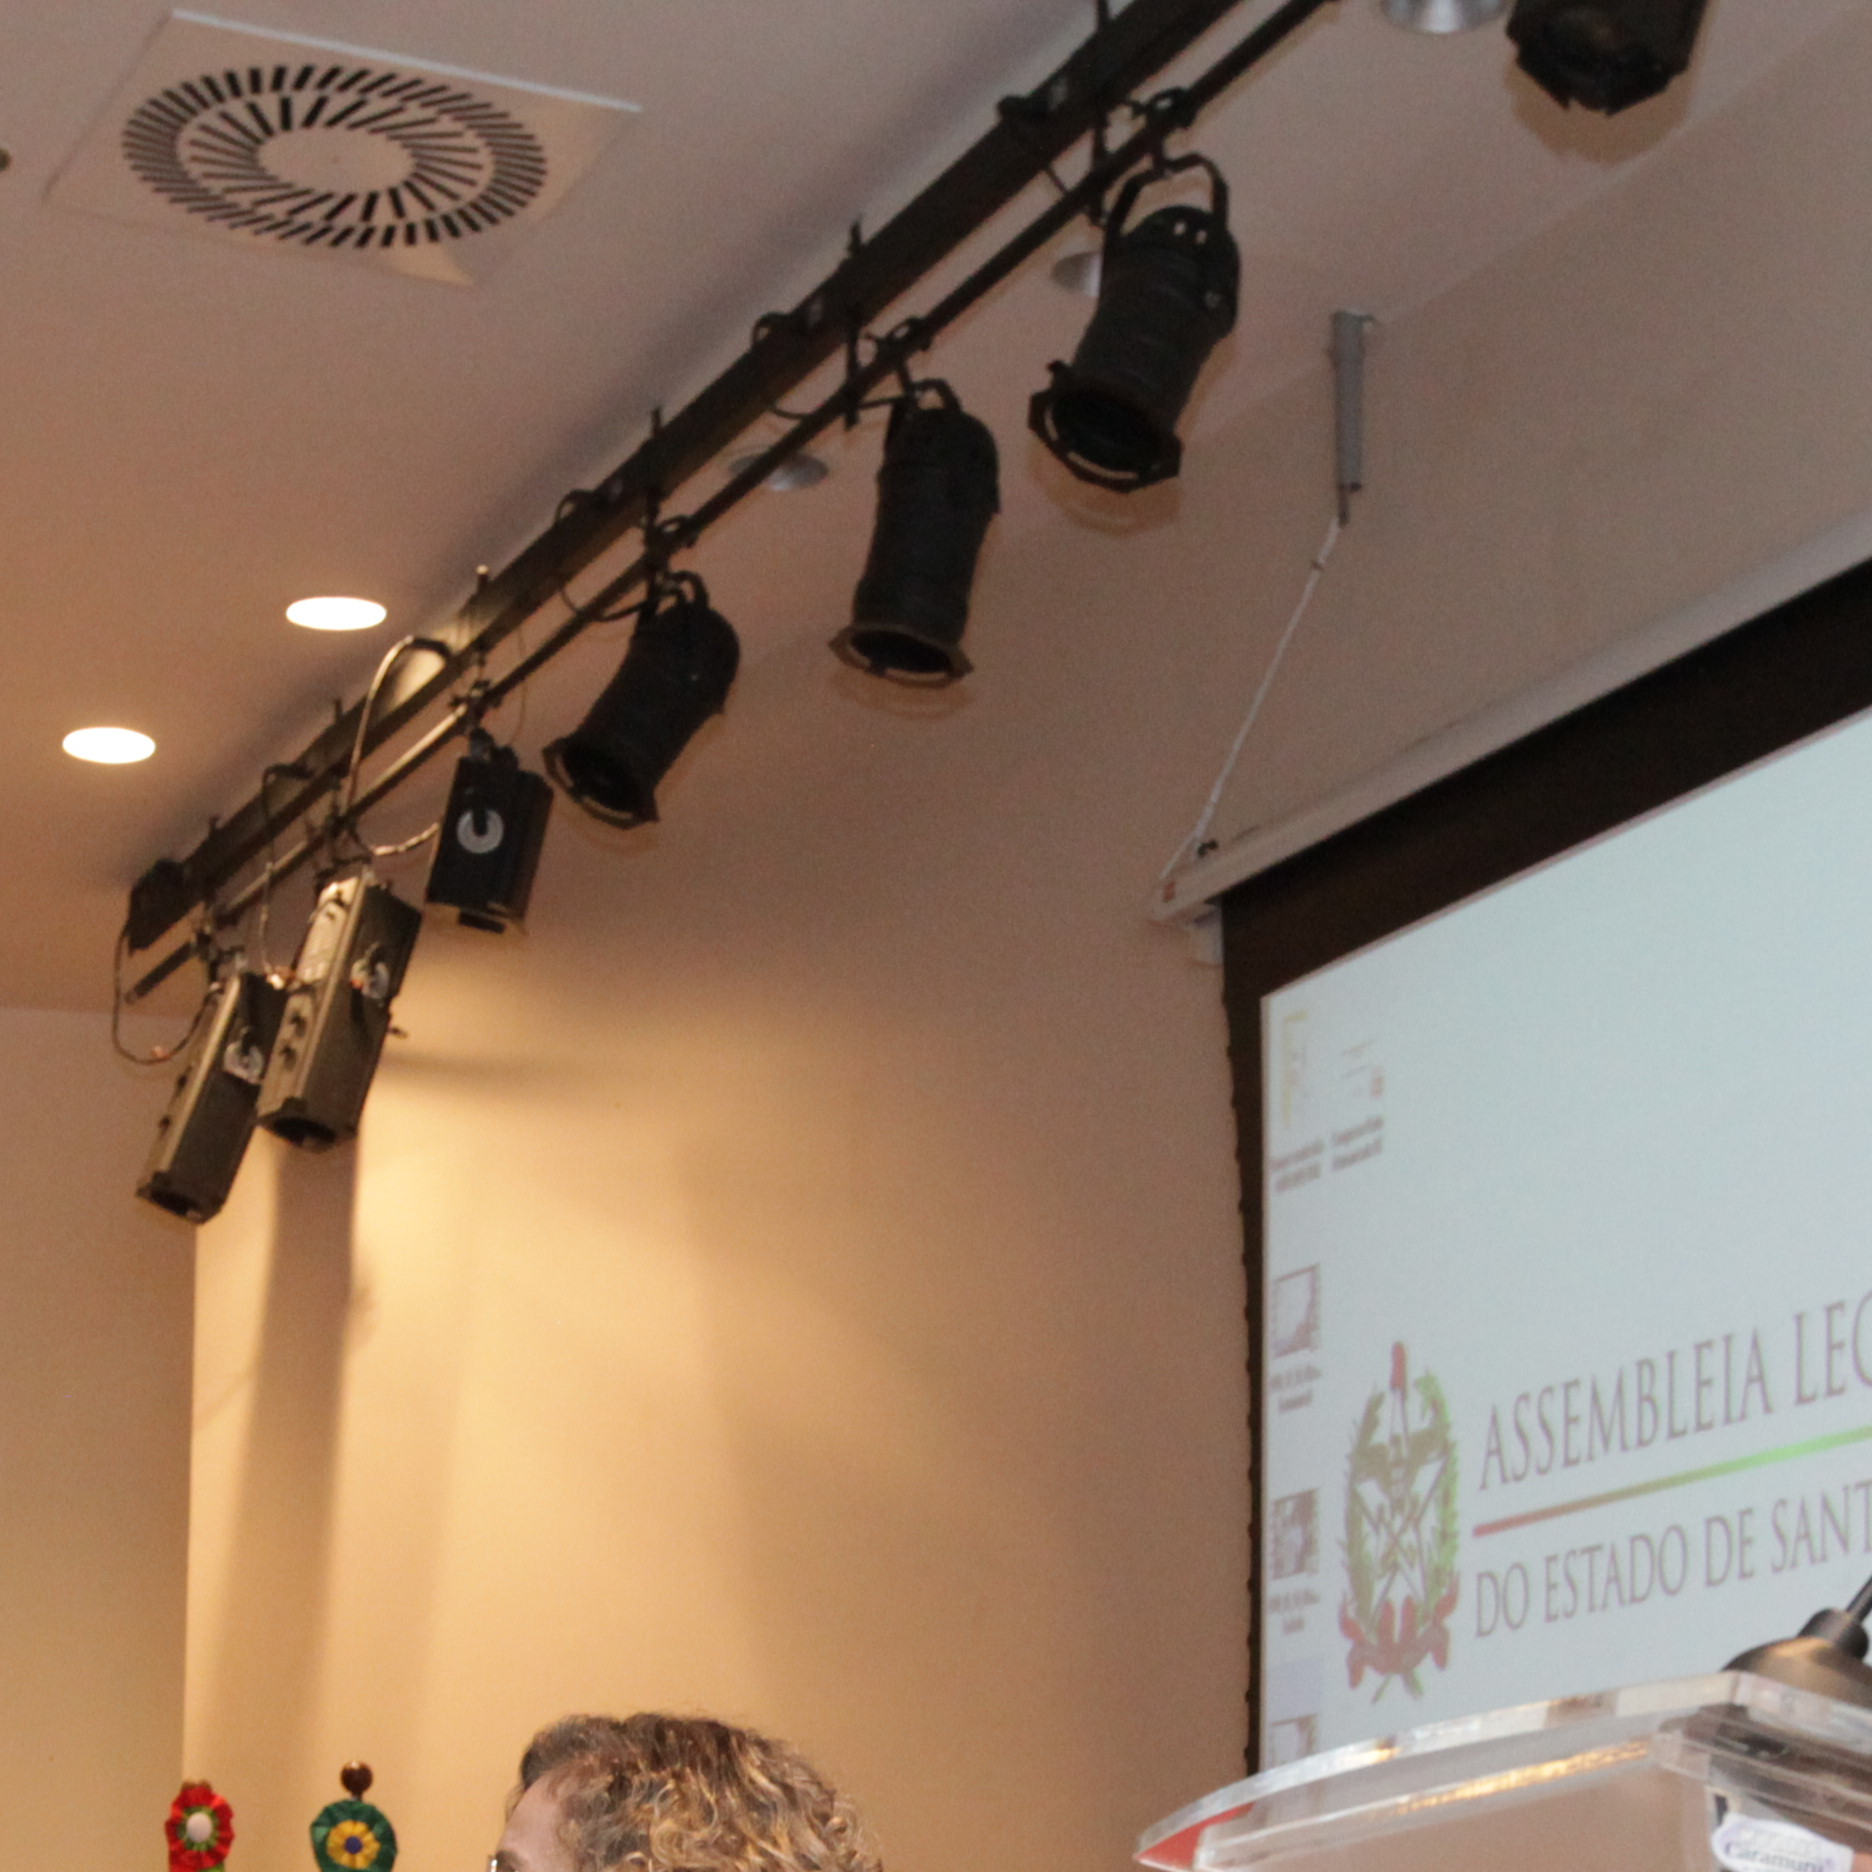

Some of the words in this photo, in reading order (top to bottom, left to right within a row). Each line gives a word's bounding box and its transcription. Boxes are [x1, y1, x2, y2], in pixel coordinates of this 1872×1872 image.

[1479, 1327, 1774, 1492] ASSEMBLEIA
[1475, 1562, 1528, 1638] DO
[1543, 1524, 1688, 1623] ESTADO
[1704, 1507, 1755, 1588] DE
